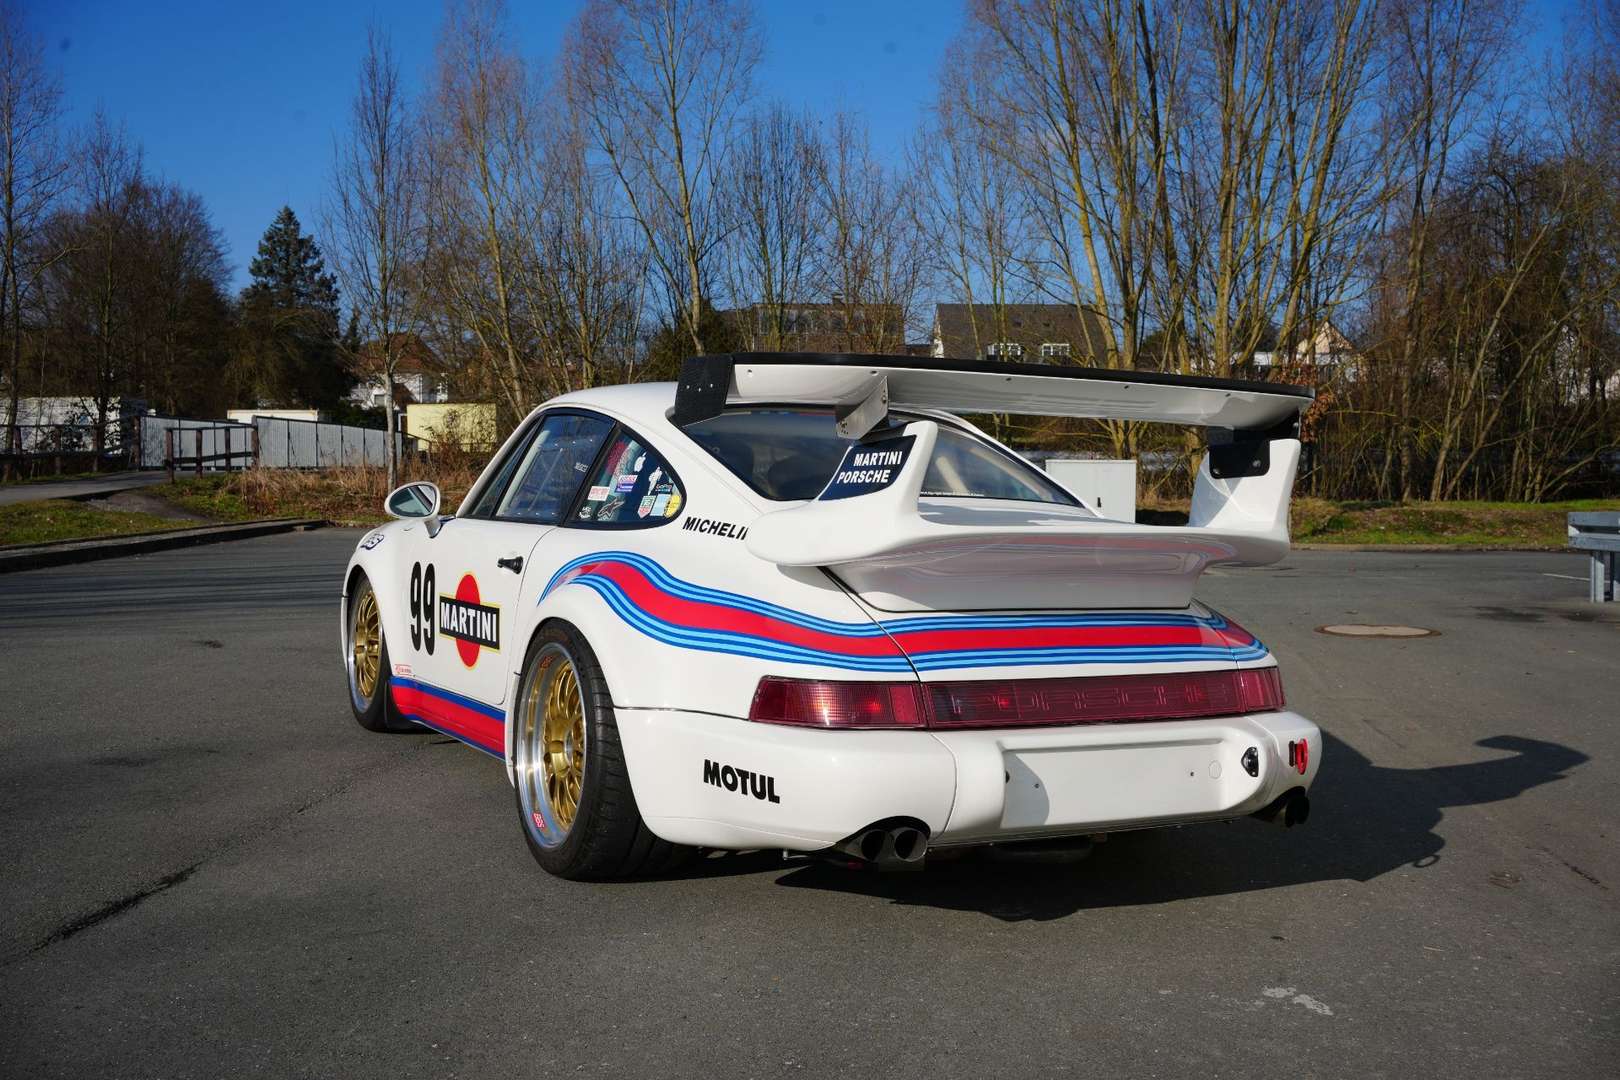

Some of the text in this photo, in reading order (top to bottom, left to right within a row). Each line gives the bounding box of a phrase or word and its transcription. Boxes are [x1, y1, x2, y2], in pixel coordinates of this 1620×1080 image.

[836, 470, 891, 484] PORSCHE
[853, 451, 902, 467] MARTINI
[410, 561, 435, 656] 99
[440, 601, 497, 642] MARTINI
[703, 759, 780, 804] MOTUL
